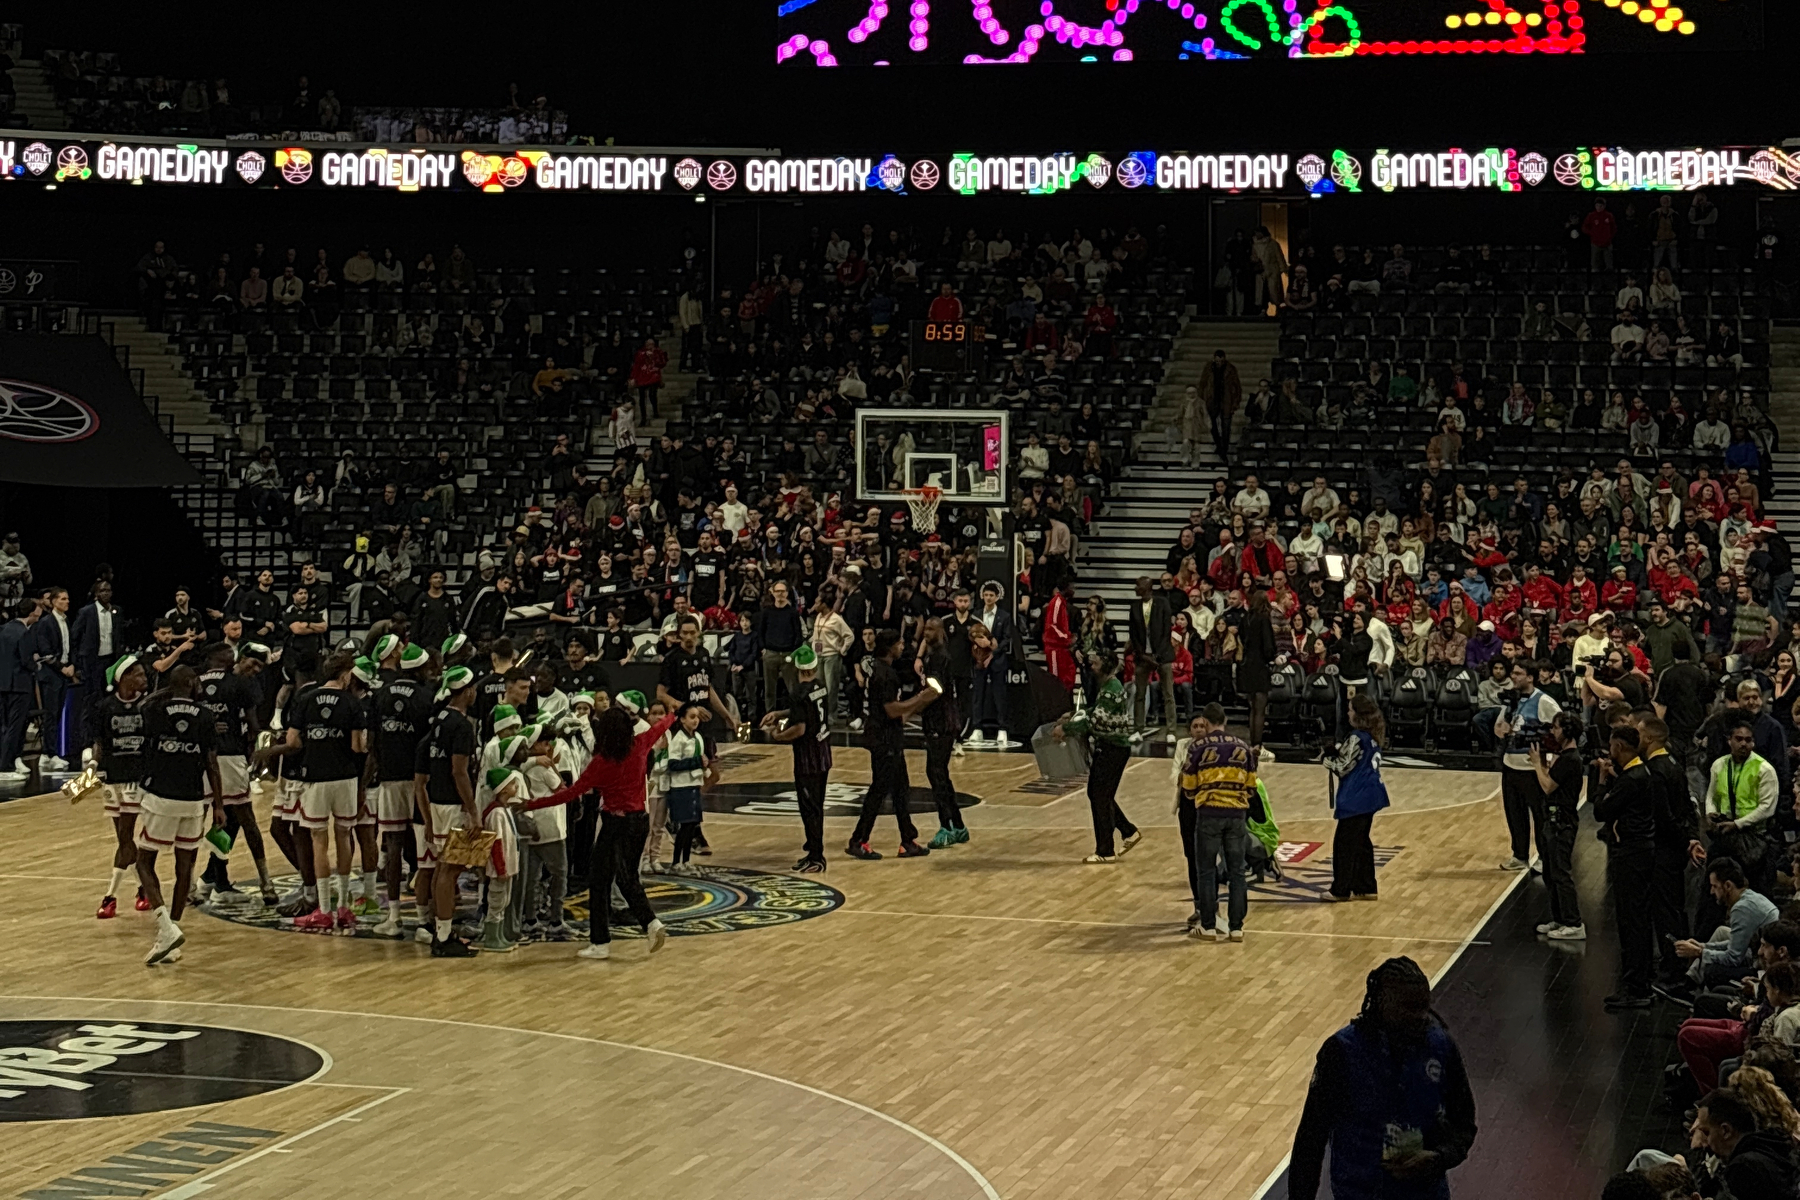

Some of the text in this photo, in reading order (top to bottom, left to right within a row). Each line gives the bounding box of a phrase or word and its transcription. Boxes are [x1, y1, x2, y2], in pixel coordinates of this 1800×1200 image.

[23, 151, 52, 164] CHOLET
[97, 146, 229, 184] GAMEDAY
[236, 159, 266, 173] CHOLET
[322, 152, 456, 187] GAMEDAY
[536, 156, 667, 191] GAMEDAY
[674, 167, 703, 179] CHOLET
[878, 165, 906, 179] CHOLET
[948, 156, 1076, 190] GAMEDAY
[1156, 154, 1288, 189] GAMEDAY
[1296, 162, 1326, 175] CHOLET
[1371, 152, 1509, 188] GAMEDAY
[1518, 161, 1548, 174] CHOLET
[1596, 150, 1740, 186] GAMEDAY
[745, 158, 872, 192] GAMEDAY
[925, 324, 966, 341] 8:59
[0, 1024, 202, 1099] yBet
